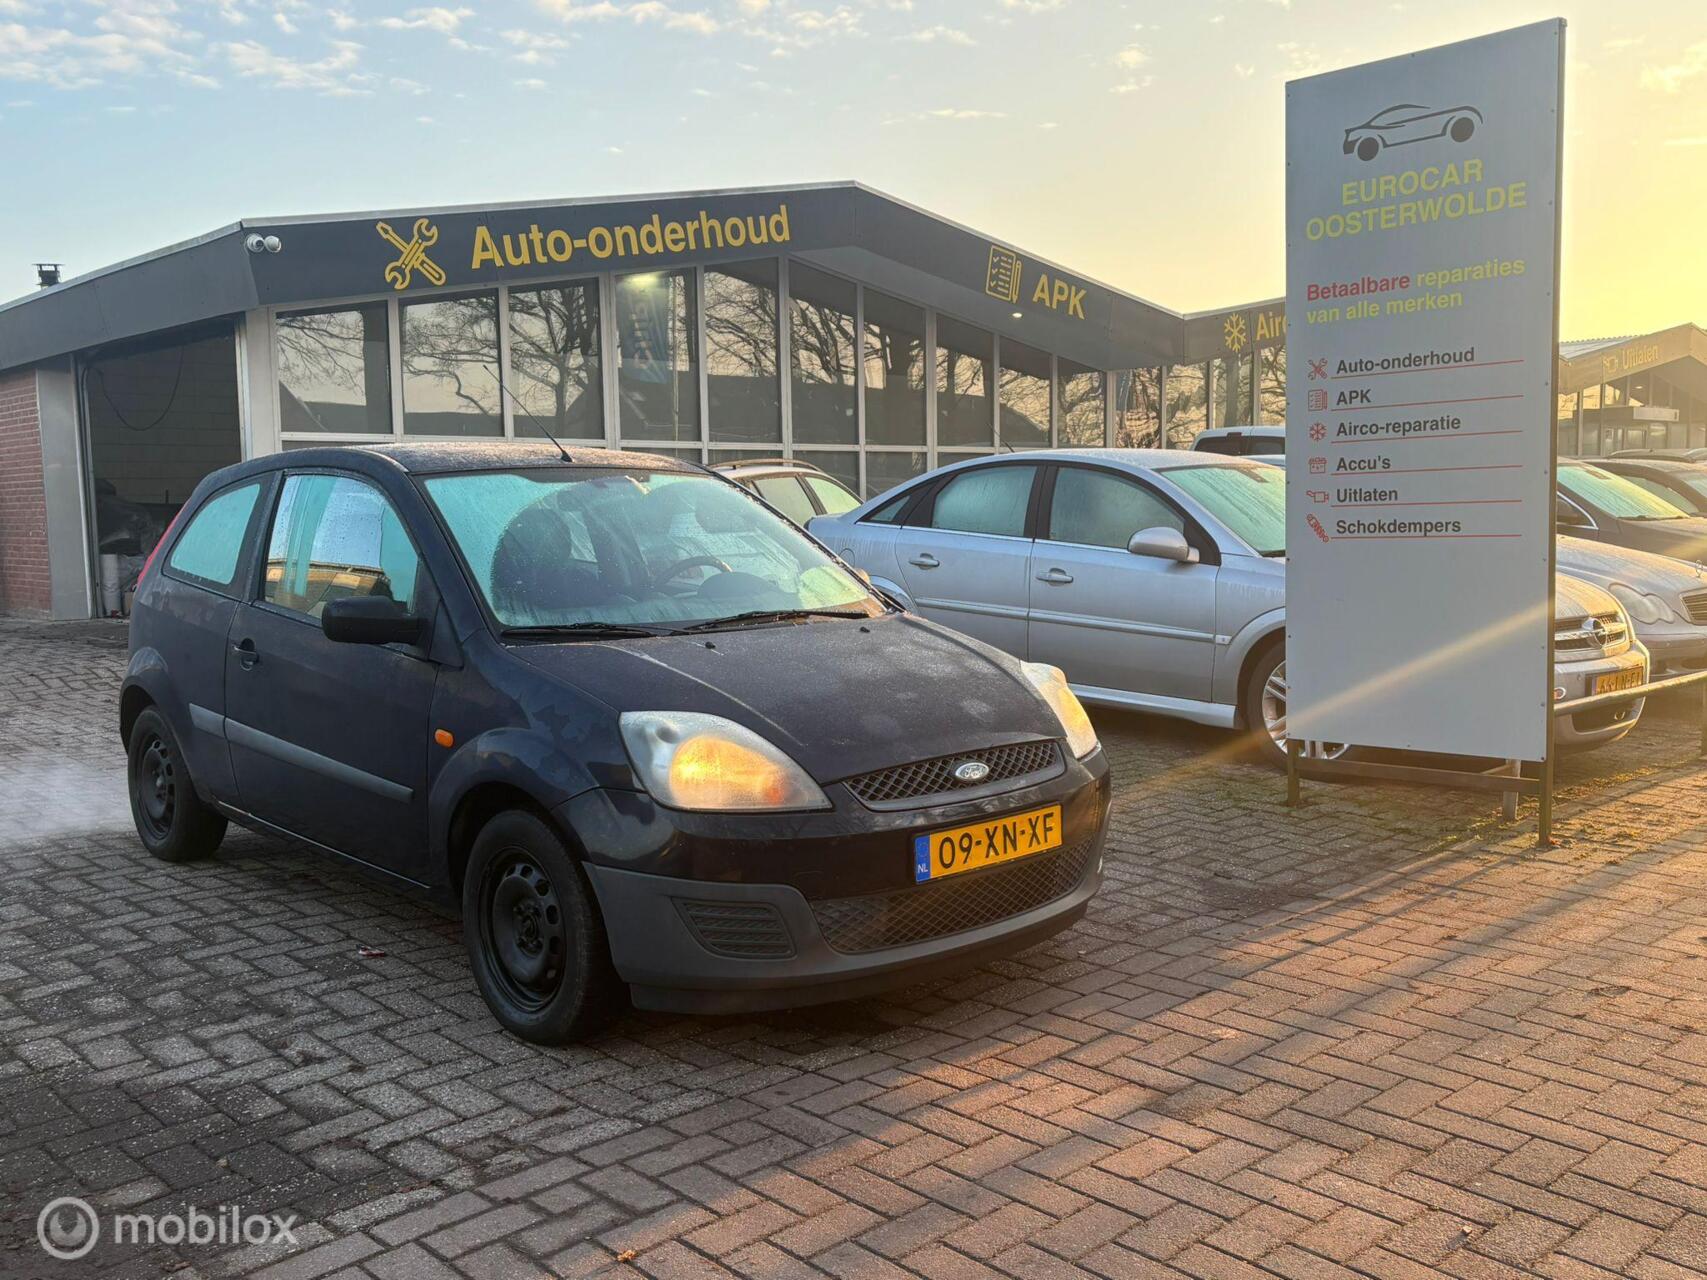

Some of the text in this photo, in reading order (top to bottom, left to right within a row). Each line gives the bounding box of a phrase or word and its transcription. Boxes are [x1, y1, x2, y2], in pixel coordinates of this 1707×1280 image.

[1342, 159, 1483, 206] EUROCAR
[1306, 181, 1528, 241] OOSTERWOLDE
[471, 204, 791, 269] Auto-onderhoud
[1307, 258, 1526, 302] Betaalbare reparaties
[1032, 274, 1088, 320] APK
[1307, 291, 1463, 325] van alle merken
[1336, 347, 1475, 374] Auto-onderhoud
[1336, 389, 1372, 406] APK
[1336, 415, 1461, 437] Airco-reparatie
[1336, 456, 1391, 472] Accu's
[1336, 488, 1398, 503] Uitlaten
[1336, 519, 1461, 537] Schokdempers
[961, 764, 986, 779] Ford
[917, 812, 1054, 873] NL 09-XN-XF
